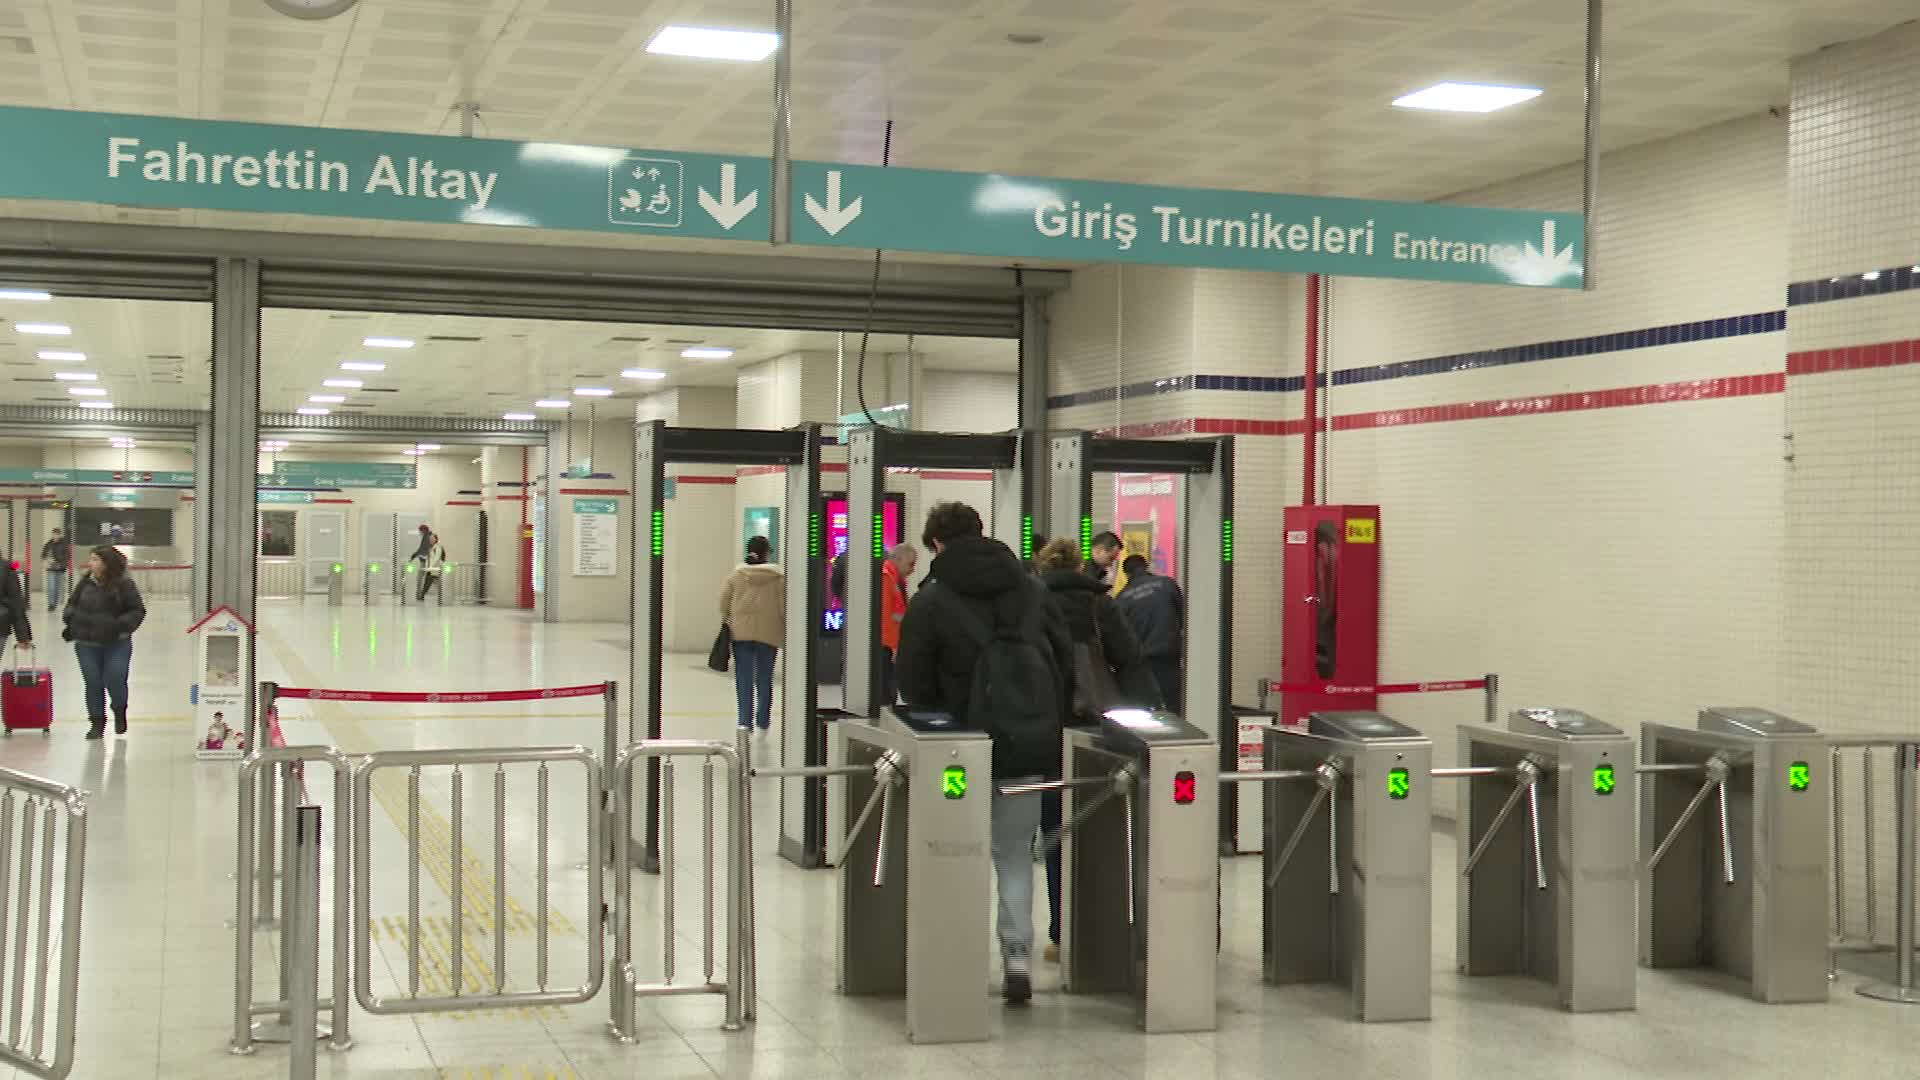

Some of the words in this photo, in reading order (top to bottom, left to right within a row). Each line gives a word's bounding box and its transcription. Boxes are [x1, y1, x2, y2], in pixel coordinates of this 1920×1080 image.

[108, 136, 349, 193] Fahrettin
[365, 153, 498, 210] Altay
[1035, 199, 1138, 251] Giriş
[1153, 206, 1376, 257] Turnikeleri
